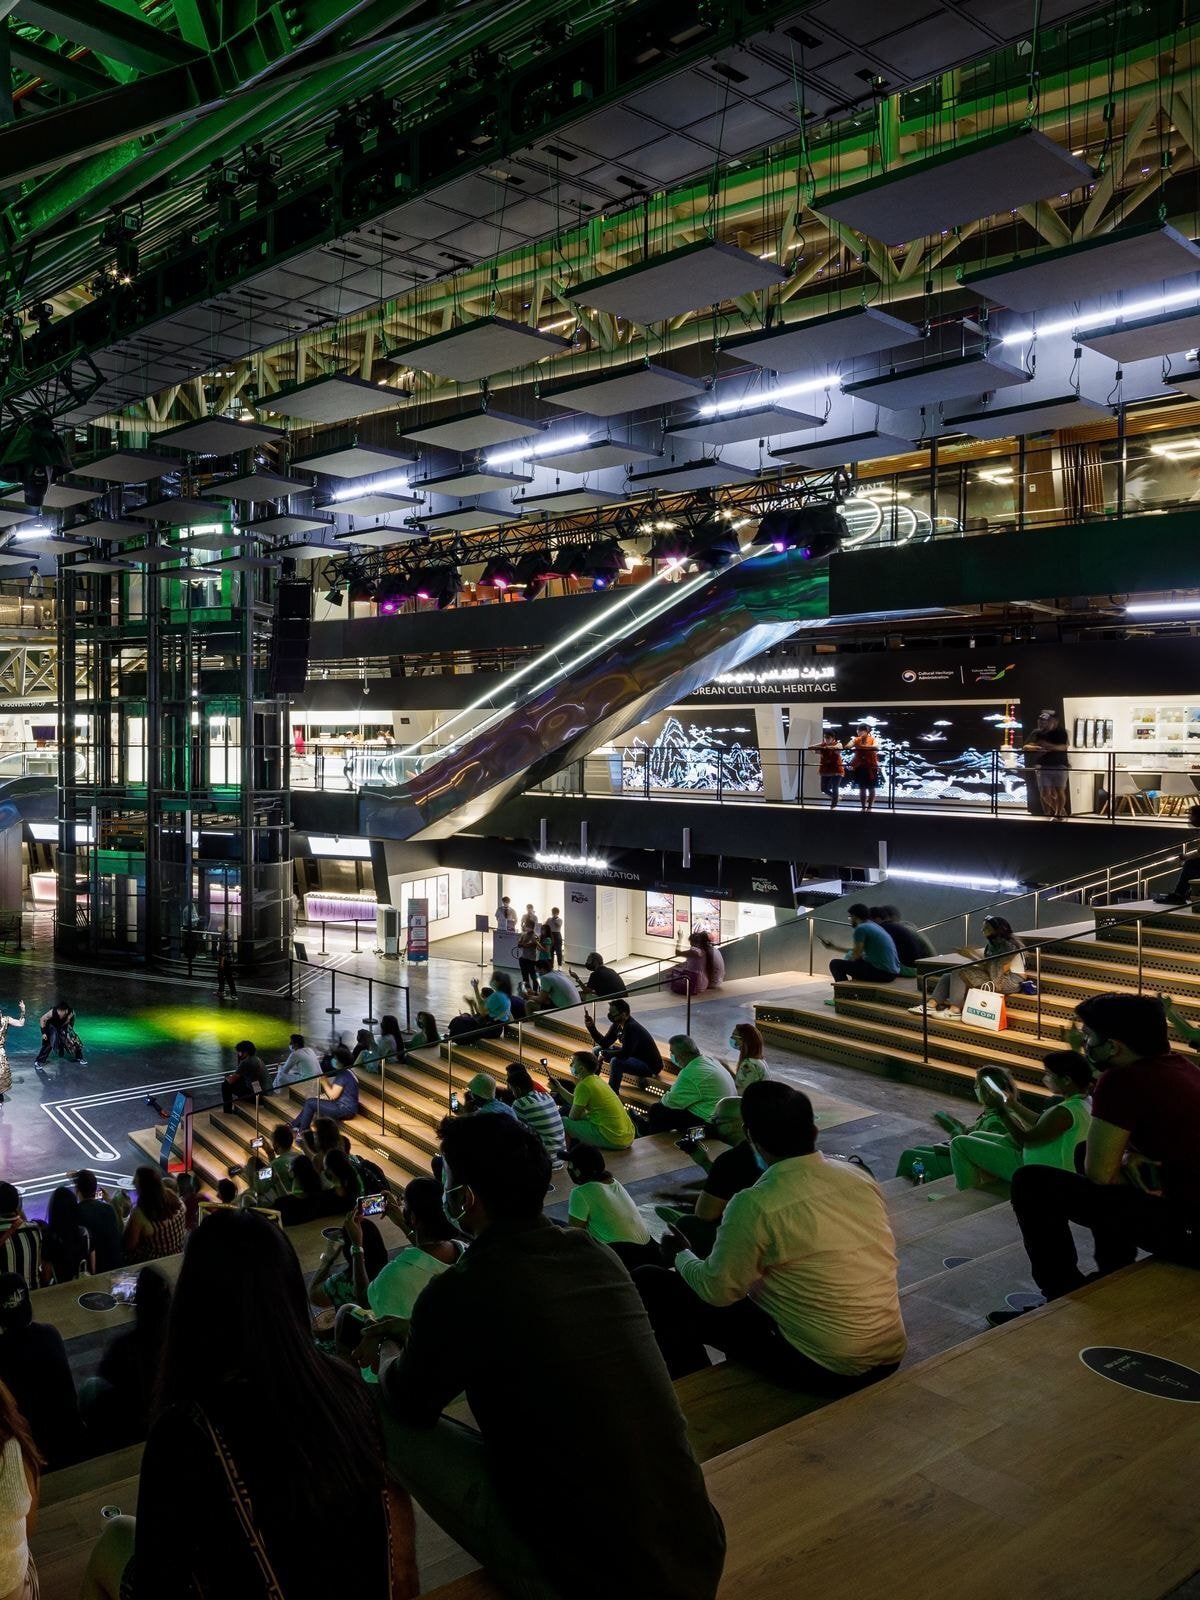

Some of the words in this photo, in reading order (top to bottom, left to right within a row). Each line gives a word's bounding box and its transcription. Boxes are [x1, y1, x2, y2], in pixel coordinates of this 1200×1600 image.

[689, 686, 726, 695] OREAN
[728, 684, 780, 694] CULTURAL
[783, 682, 837, 693] HERITAGE
[517, 861, 541, 870] KOREA
[542, 863, 577, 874] TOURISM
[579, 866, 640, 881] ORGANIZATION
